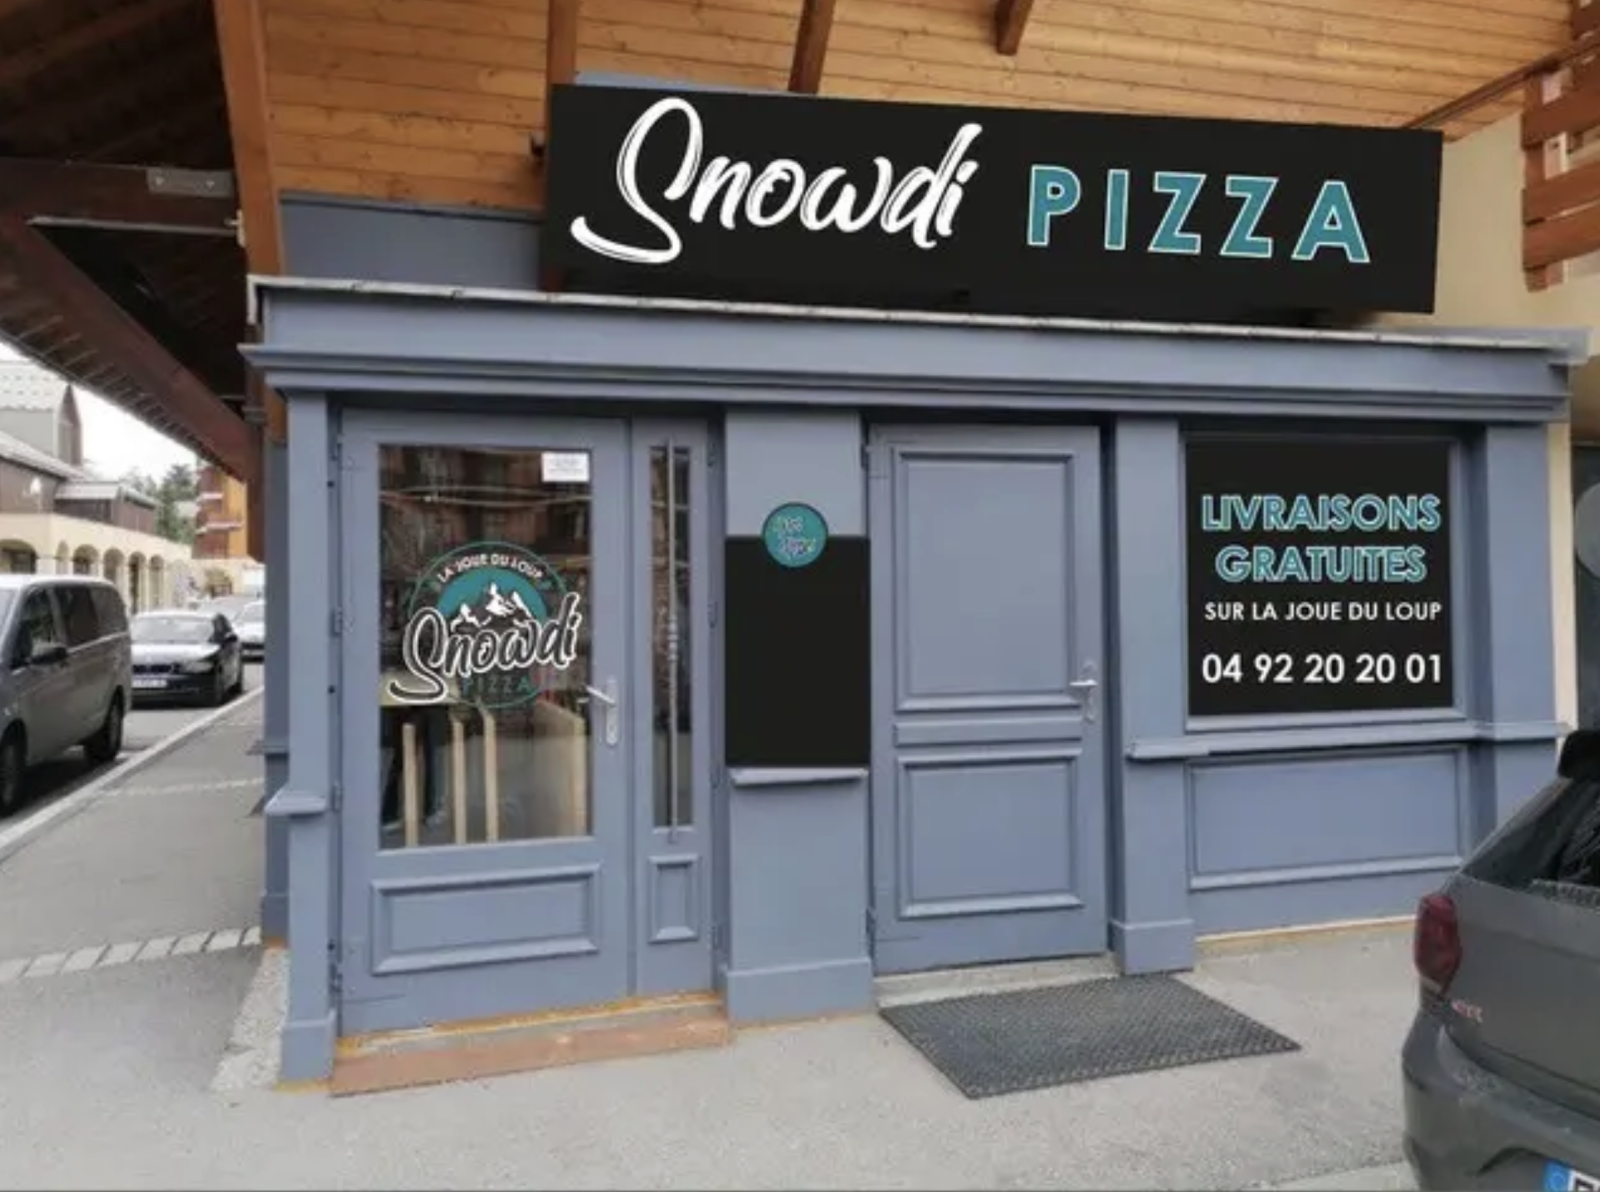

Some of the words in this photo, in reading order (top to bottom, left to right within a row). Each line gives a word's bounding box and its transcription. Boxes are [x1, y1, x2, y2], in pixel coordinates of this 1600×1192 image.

[570, 98, 982, 264] Snowdi
[1027, 164, 1370, 264] PIZZA
[1201, 494, 1441, 532] LIVRAISONS
[437, 567, 455, 582] LA
[456, 553, 487, 572] JOUE
[490, 553, 510, 566] DU
[1215, 545, 1427, 582] GRATUITES
[1204, 602, 1244, 621] SUR
[1253, 602, 1278, 620] LA
[1285, 602, 1342, 621] JOUE
[1349, 602, 1378, 621] DU
[1385, 602, 1442, 621] LOUP
[388, 592, 582, 705] Snowdi
[1202, 654, 1243, 684] 04
[1254, 654, 1293, 683] 92
[1303, 654, 1345, 684] 20
[1355, 654, 1396, 684] 20
[1406, 654, 1441, 684] 01
